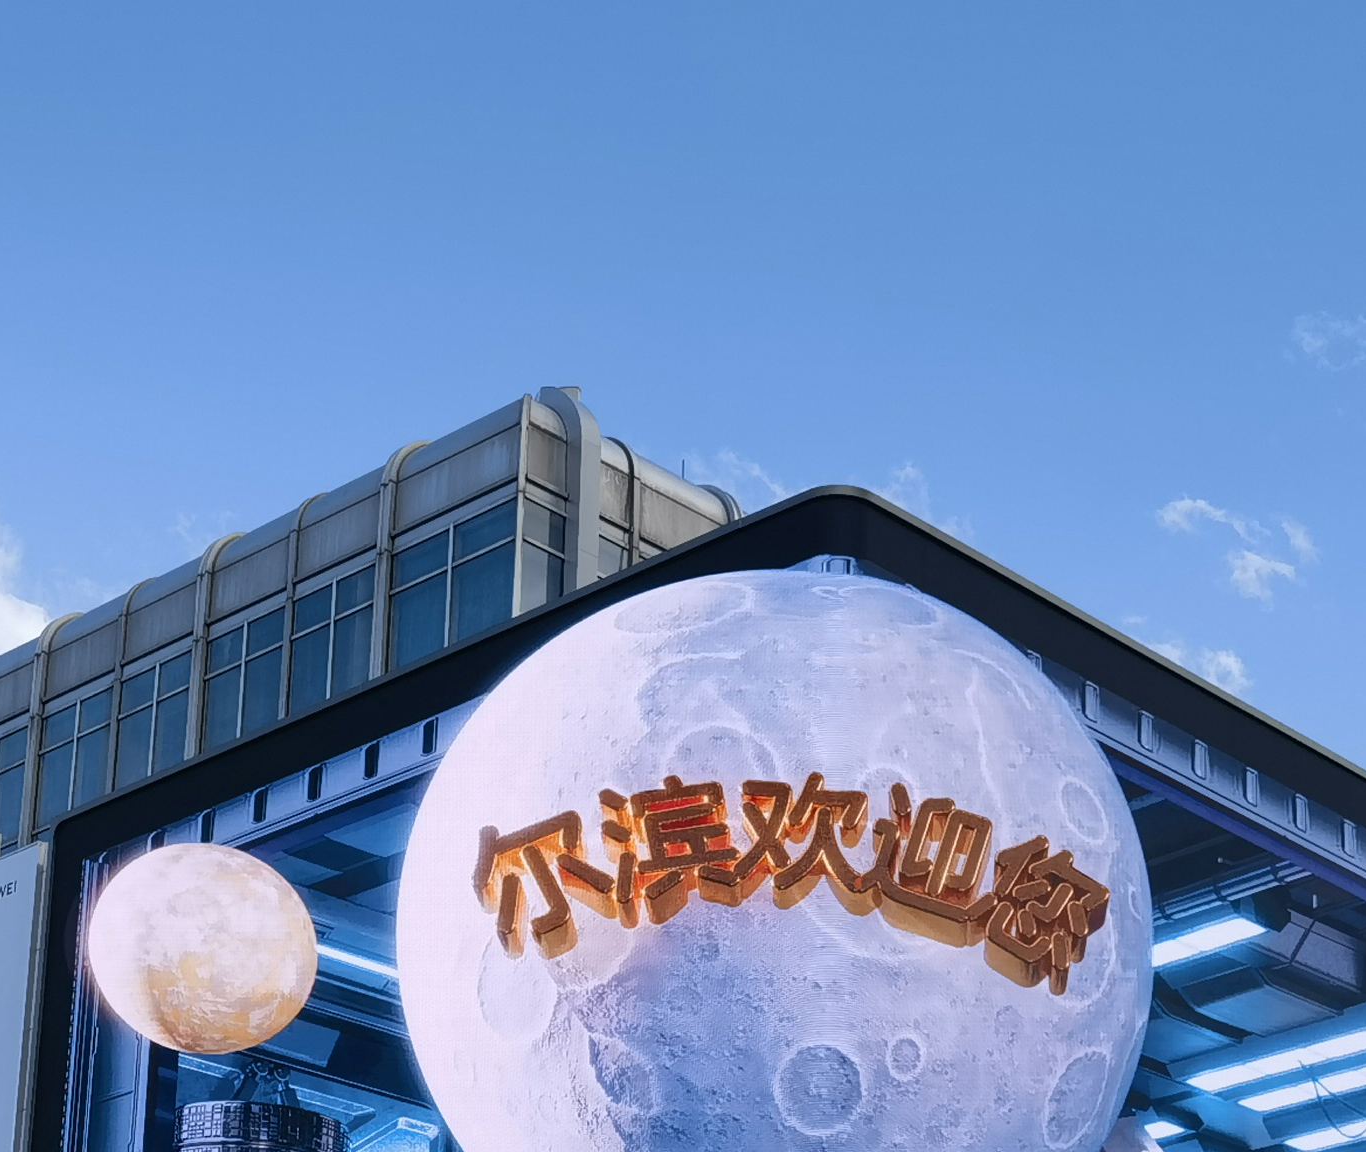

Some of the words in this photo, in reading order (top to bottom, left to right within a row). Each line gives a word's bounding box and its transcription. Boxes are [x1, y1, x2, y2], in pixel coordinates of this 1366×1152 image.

[472, 772, 1110, 995] 尔滨欢迎您
